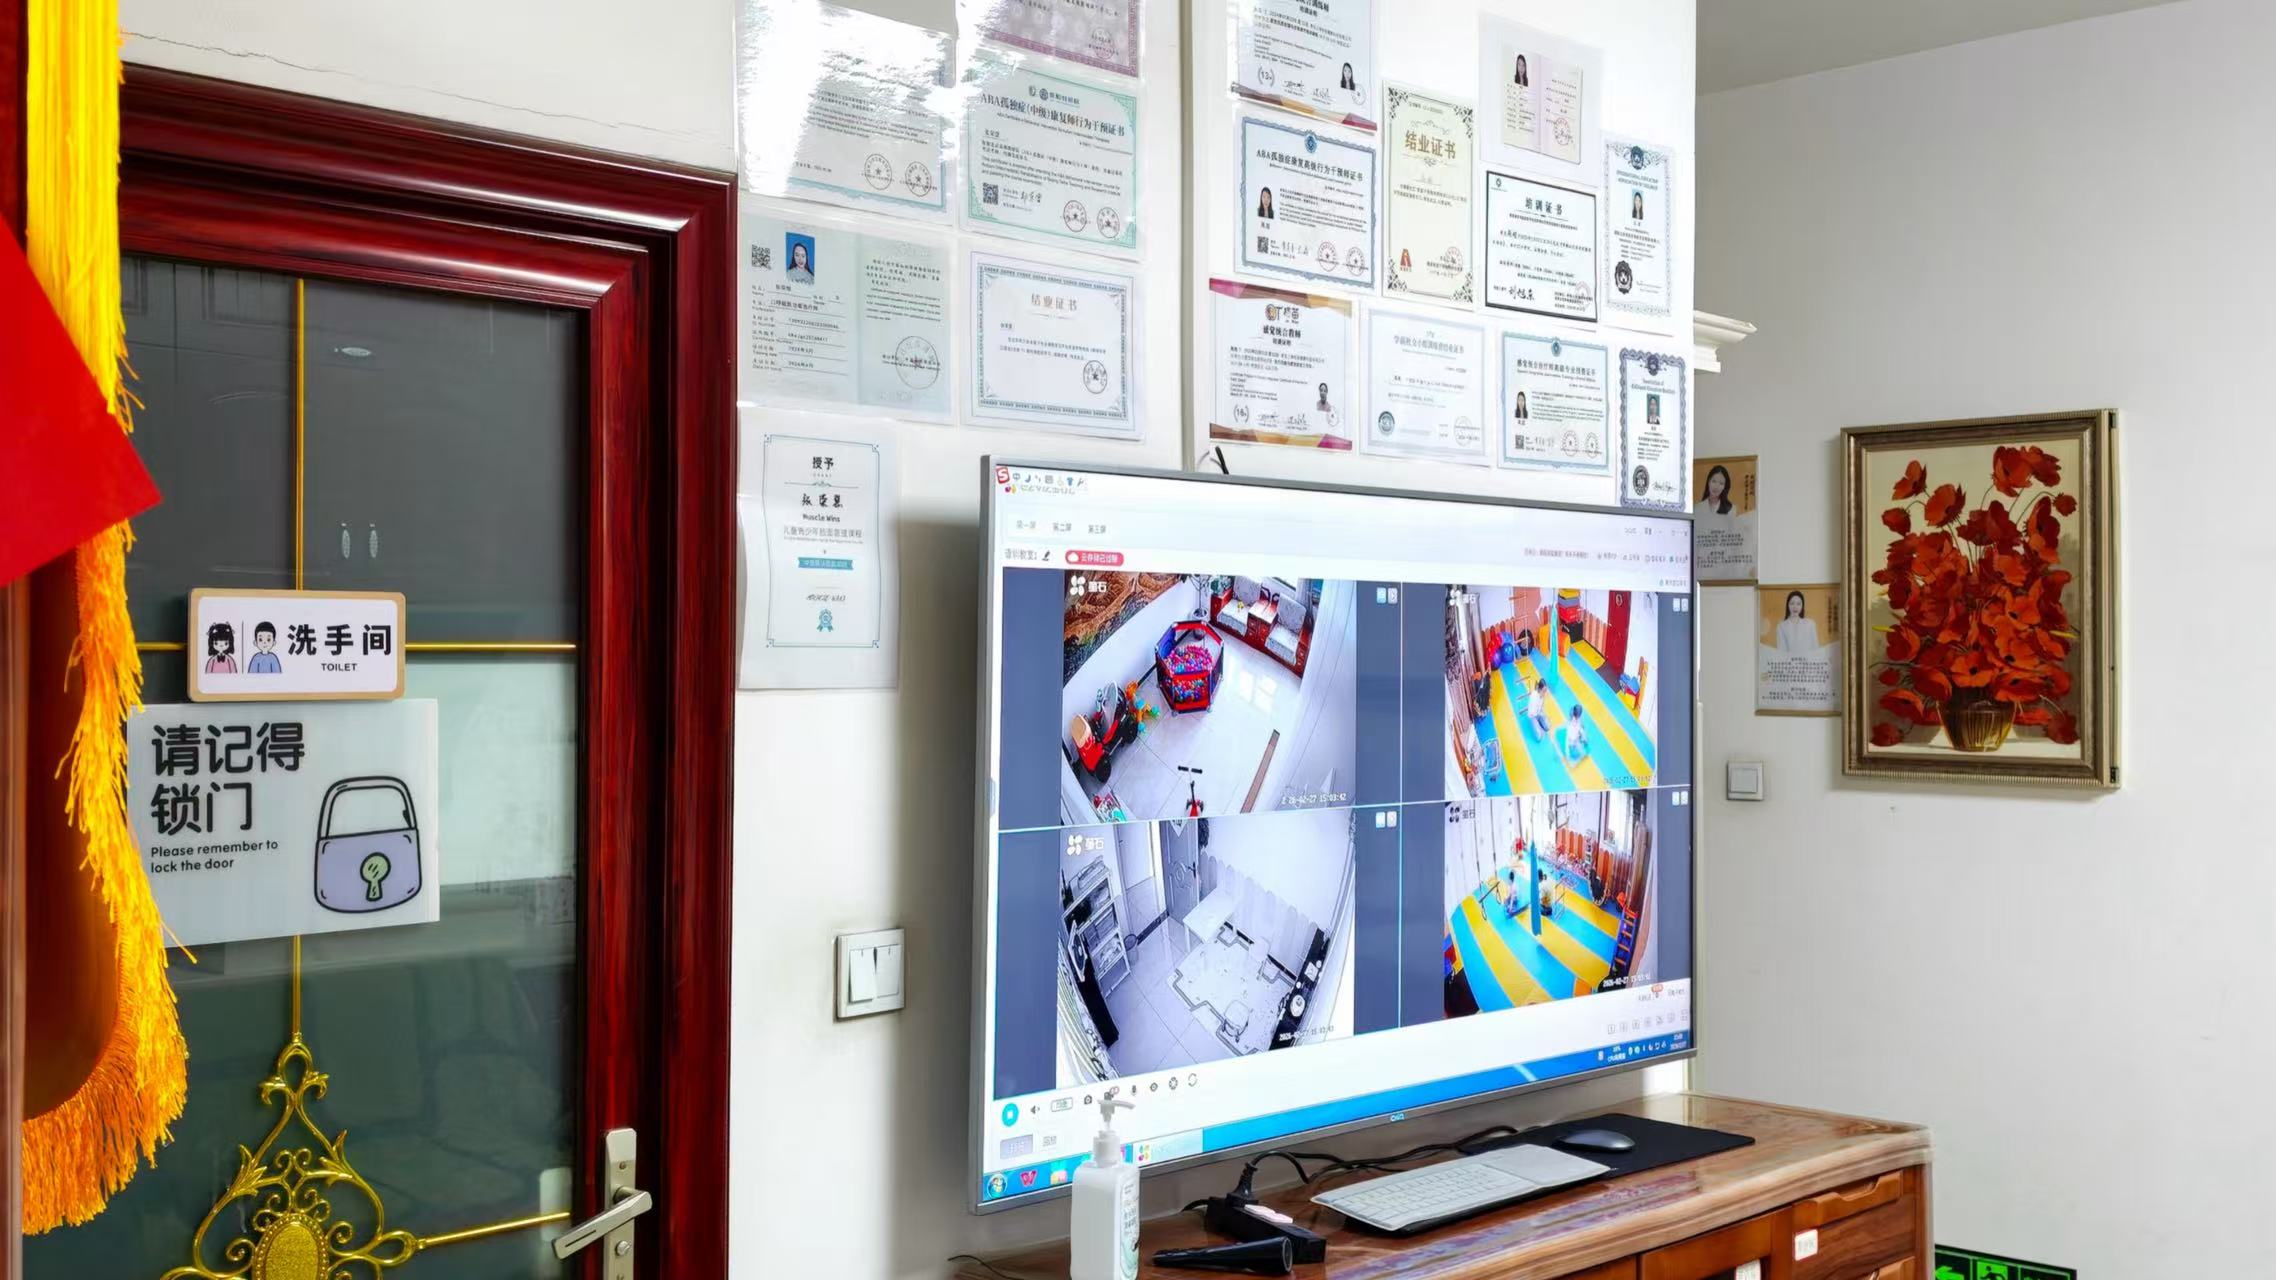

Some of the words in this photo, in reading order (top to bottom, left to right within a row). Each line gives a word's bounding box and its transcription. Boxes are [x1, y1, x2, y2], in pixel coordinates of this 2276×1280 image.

[1405, 130, 1456, 159] 结业证书
[1031, 293, 1077, 311] 结业证书
[812, 456, 834, 470] 授予
[287, 624, 392, 656] 洗手间
[321, 663, 357, 672] TOILET
[151, 722, 305, 776] 请记得
[151, 782, 252, 836] 锁门
[151, 846, 194, 858] Please
[197, 841, 262, 855] remember
[266, 839, 278, 850] to
[151, 861, 177, 874] lock
[181, 859, 201, 871] the
[205, 858, 234, 870] door
